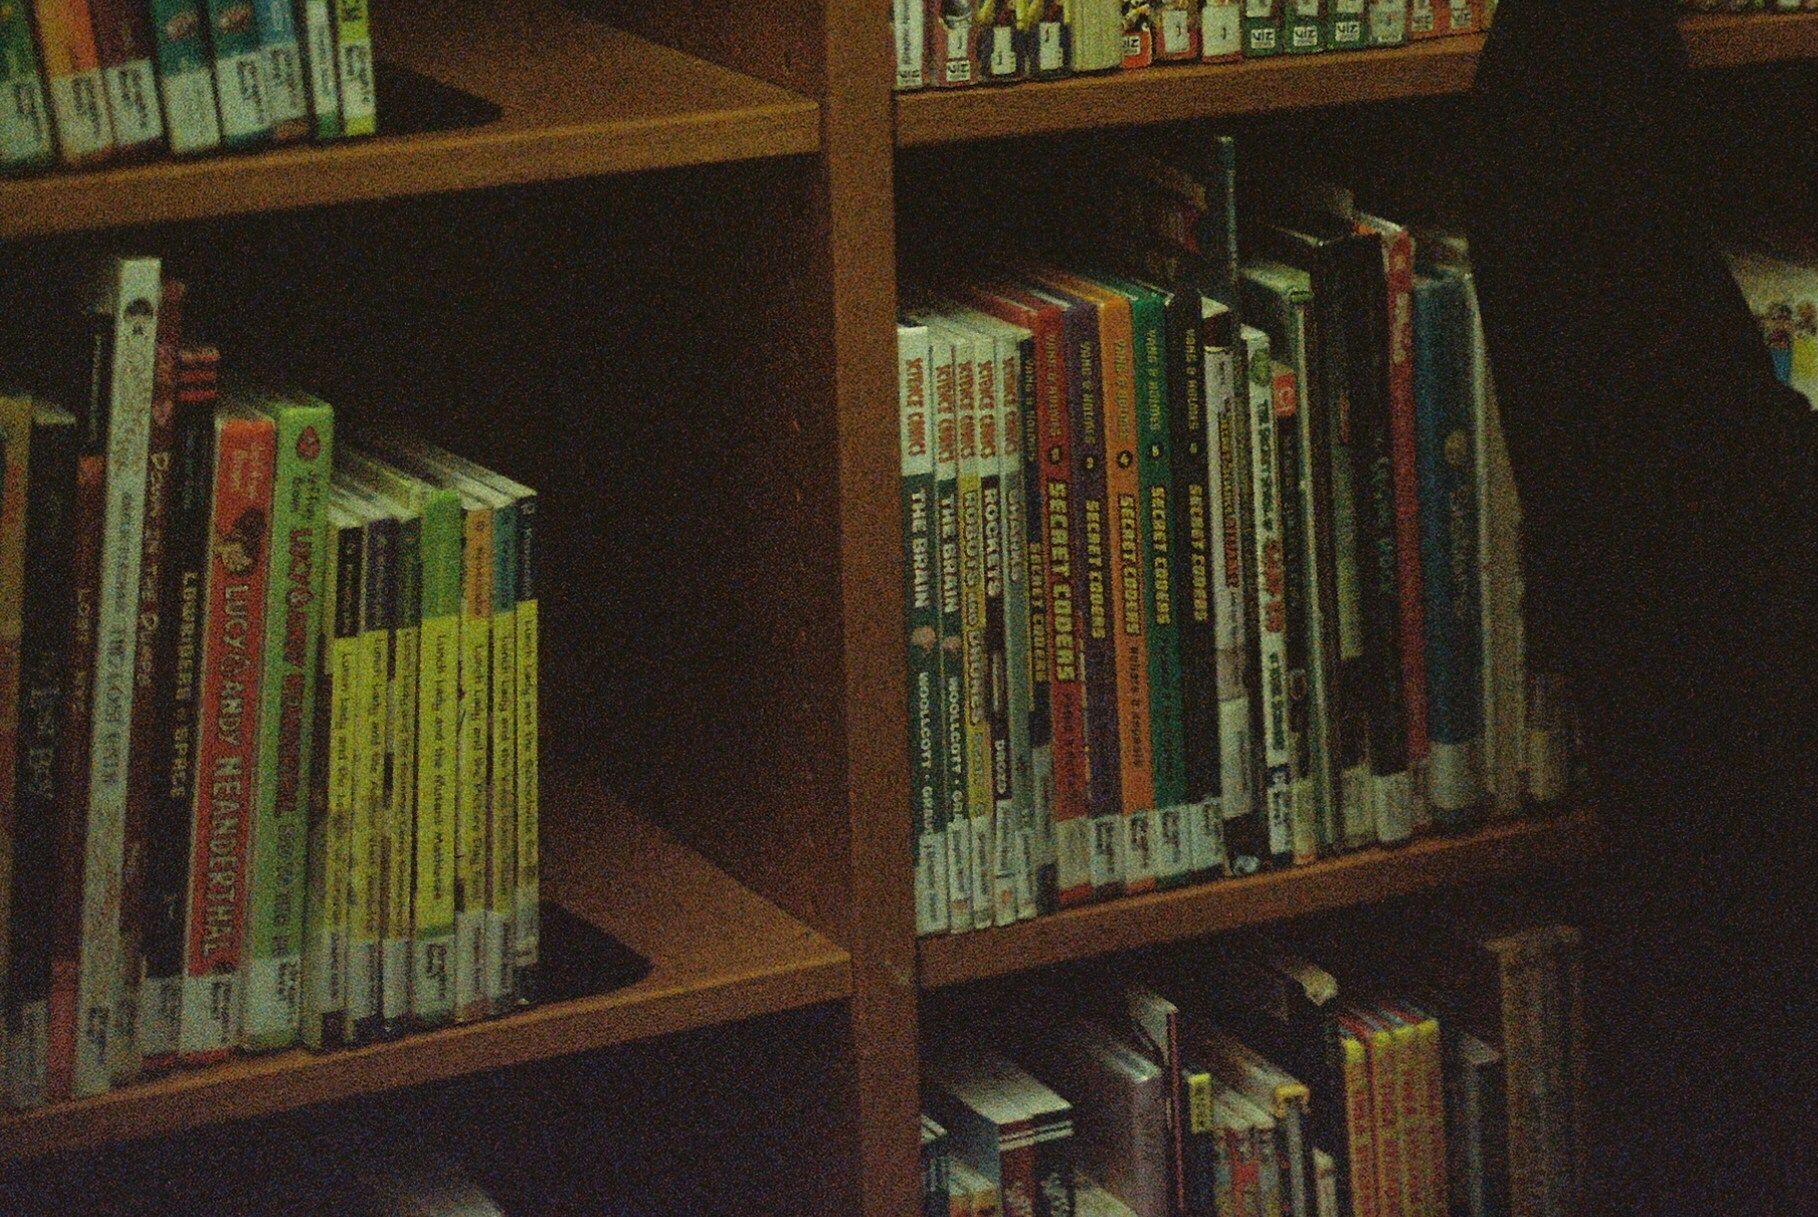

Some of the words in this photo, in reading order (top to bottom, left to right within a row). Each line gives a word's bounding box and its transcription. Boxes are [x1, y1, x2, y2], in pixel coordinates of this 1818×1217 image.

[911, 488, 927, 533] THE
[940, 496, 955, 538] THE
[963, 490, 979, 588] ROBOTS
[984, 487, 1000, 597] ROCKETS
[1049, 480, 1072, 577] SECRET
[1085, 499, 1103, 567] SECRET
[1119, 495, 1137, 563] SECRET
[1150, 486, 1168, 553] SECRET
[1188, 484, 1206, 549] SECRET
[912, 537, 930, 610] BRAIN
[941, 543, 959, 613] BRAIN
[1088, 570, 1107, 640] CODERS
[1123, 566, 1141, 635] CODERS
[1153, 556, 1170, 625] CODERS
[1191, 553, 1209, 622] CODERS
[223, 585, 249, 650] LUCY
[1052, 581, 1076, 682] CODERS
[217, 681, 244, 745] ANDY
[918, 671, 931, 769] WOOLLCOTT
[948, 676, 962, 774] WOOLLCOTT
[202, 755, 243, 958] NEANDERTHAL
